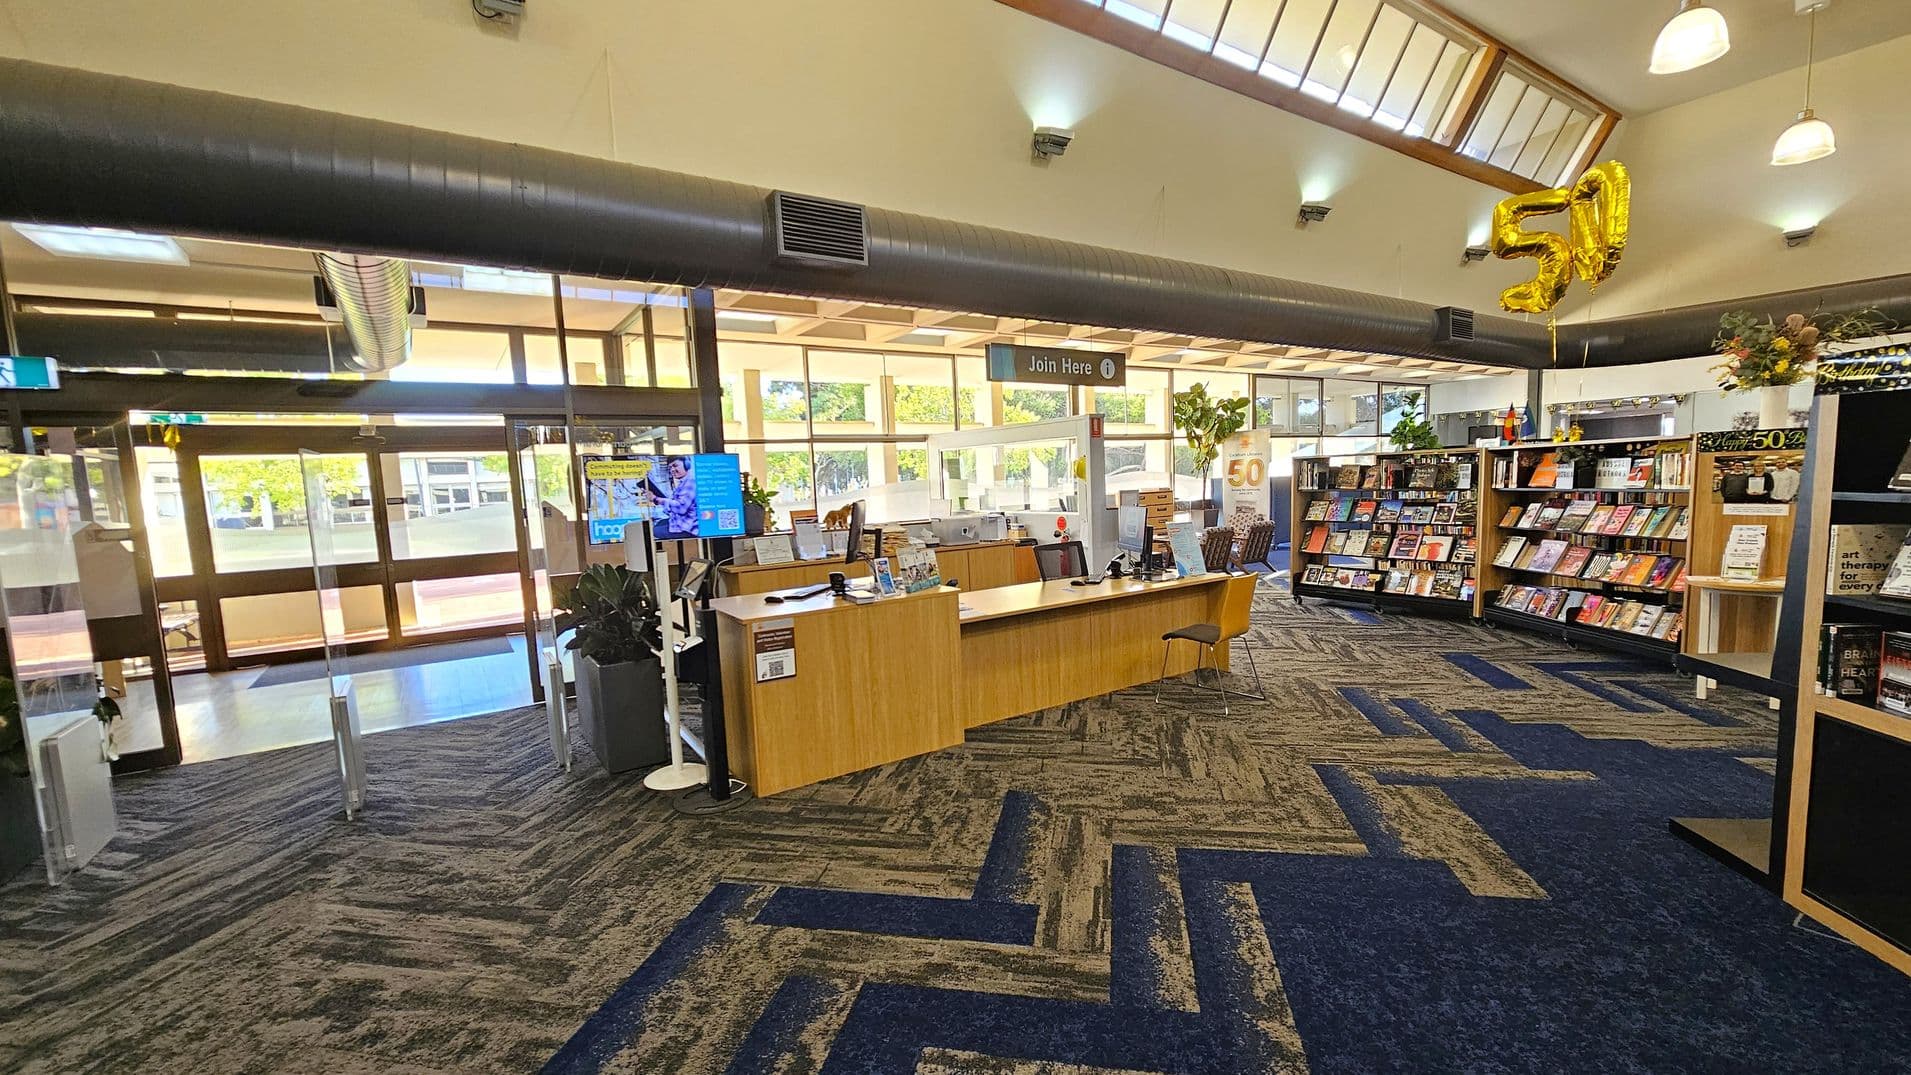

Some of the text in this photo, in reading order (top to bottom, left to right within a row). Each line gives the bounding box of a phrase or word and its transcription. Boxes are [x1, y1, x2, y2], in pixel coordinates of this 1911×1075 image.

[1029, 355, 1092, 375] Join Here
[1711, 432, 1749, 451] Happy
[1753, 430, 1786, 449] 50
[1228, 458, 1265, 487] 50
[1841, 551, 1860, 559] art
[1841, 561, 1890, 572] therapy
[1840, 571, 1859, 580] for
[1839, 583, 1874, 592] every
[1840, 667, 1876, 678] HEAR
